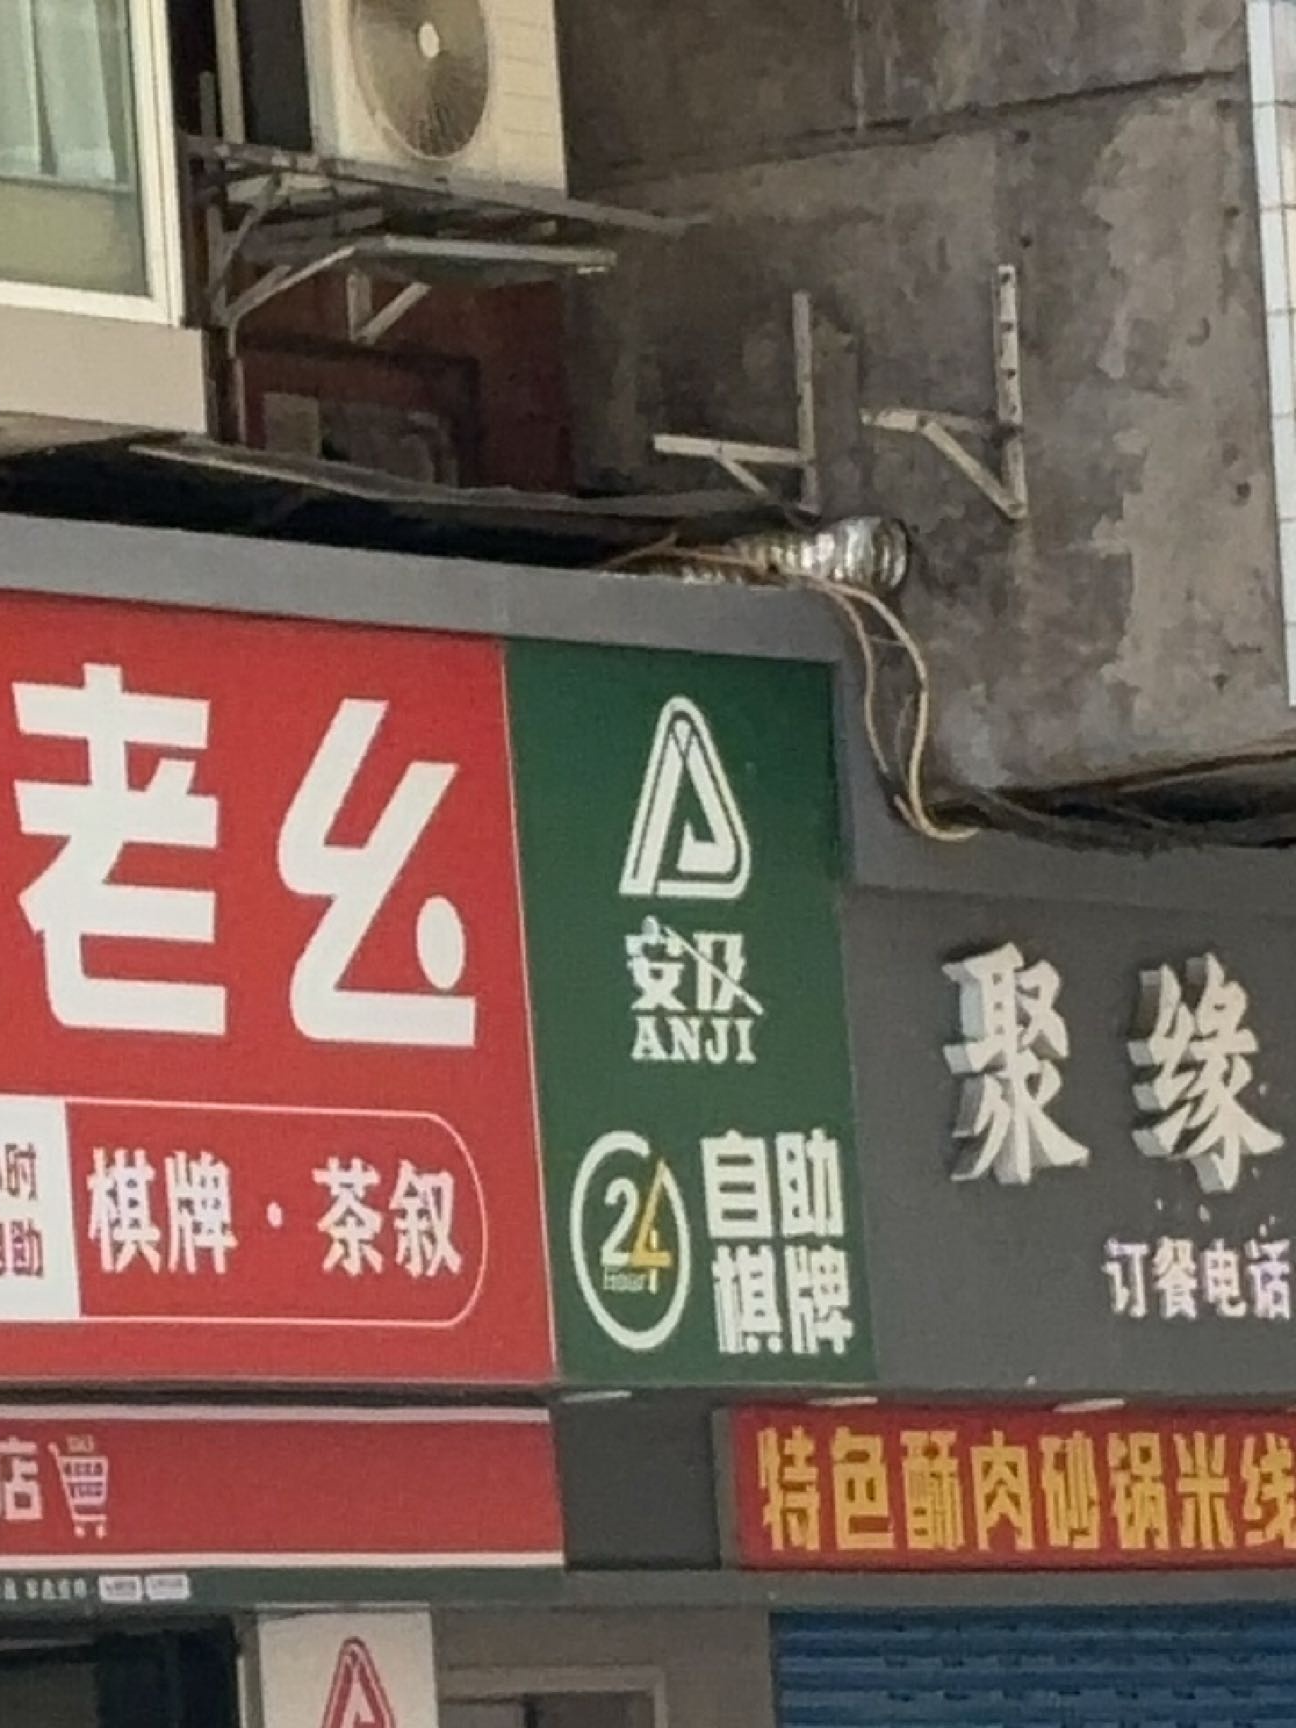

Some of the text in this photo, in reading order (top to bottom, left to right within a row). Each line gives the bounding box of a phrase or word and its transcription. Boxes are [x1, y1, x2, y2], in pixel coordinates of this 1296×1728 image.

[631, 1016, 757, 1064] ANJI
[941, 941, 1286, 1193] 聚缘
[599, 1158, 672, 1295] 24
[699, 1129, 846, 1240] 自助
[712, 1244, 856, 1355] 棋牌
[1101, 1236, 1292, 1321] 订餐电话
[754, 1425, 1296, 1552] 特色酥肉砂锅米线
